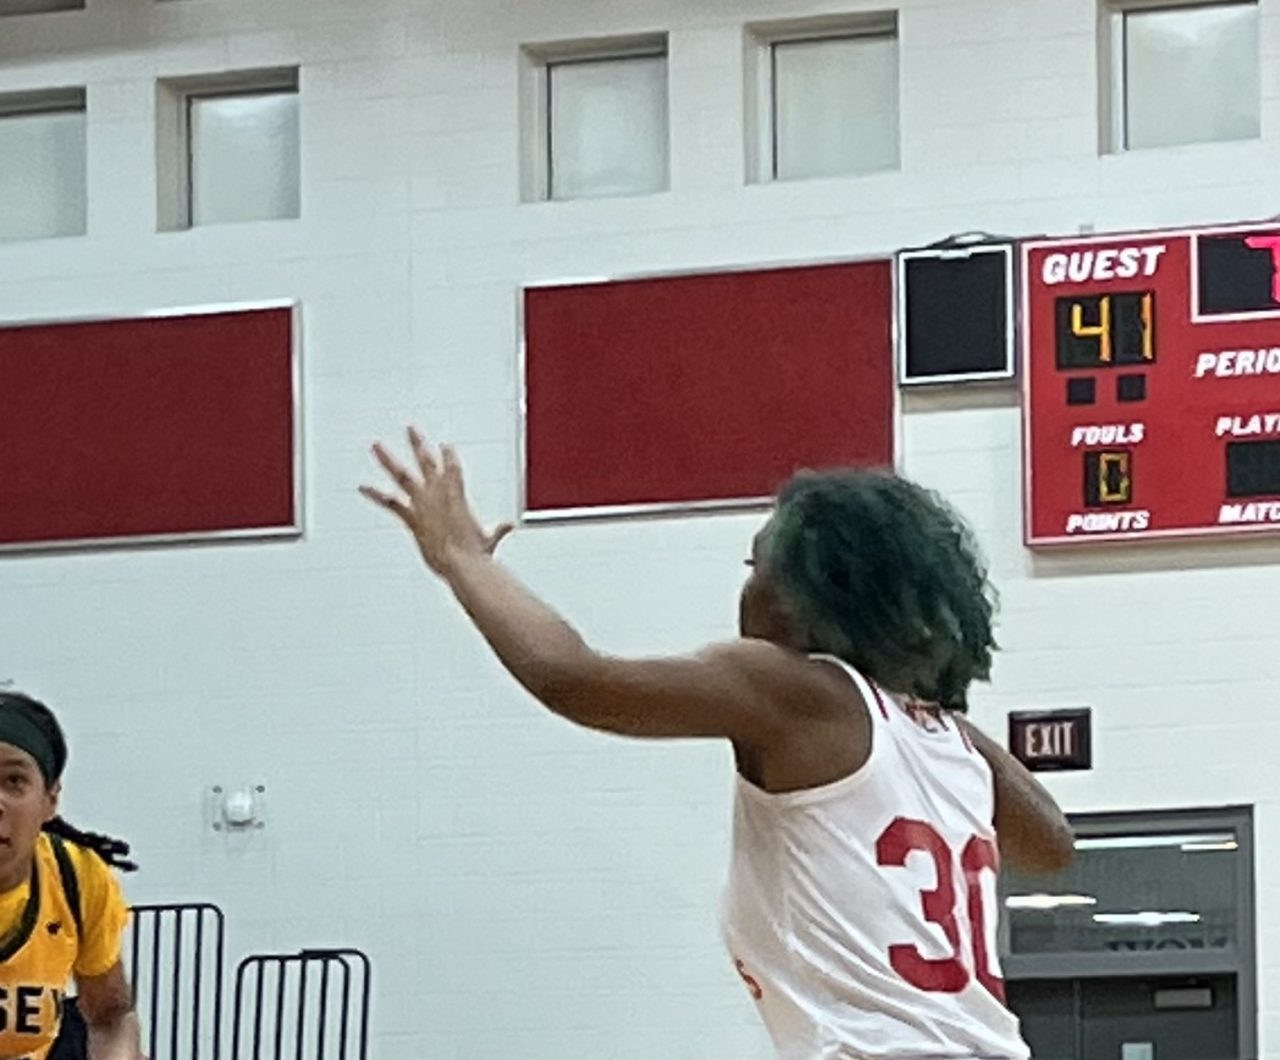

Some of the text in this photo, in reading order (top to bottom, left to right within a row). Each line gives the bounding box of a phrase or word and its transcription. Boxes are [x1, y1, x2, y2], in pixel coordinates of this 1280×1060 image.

[1042, 245, 1166, 285] GUEST
[1072, 292, 1153, 362] 41
[1070, 423, 1144, 447] FOULS
[1215, 412, 1280, 437] PLAY
[1066, 510, 1150, 533] POINTS
[1025, 721, 1073, 757] EXIT
[875, 816, 1006, 1006] 30
